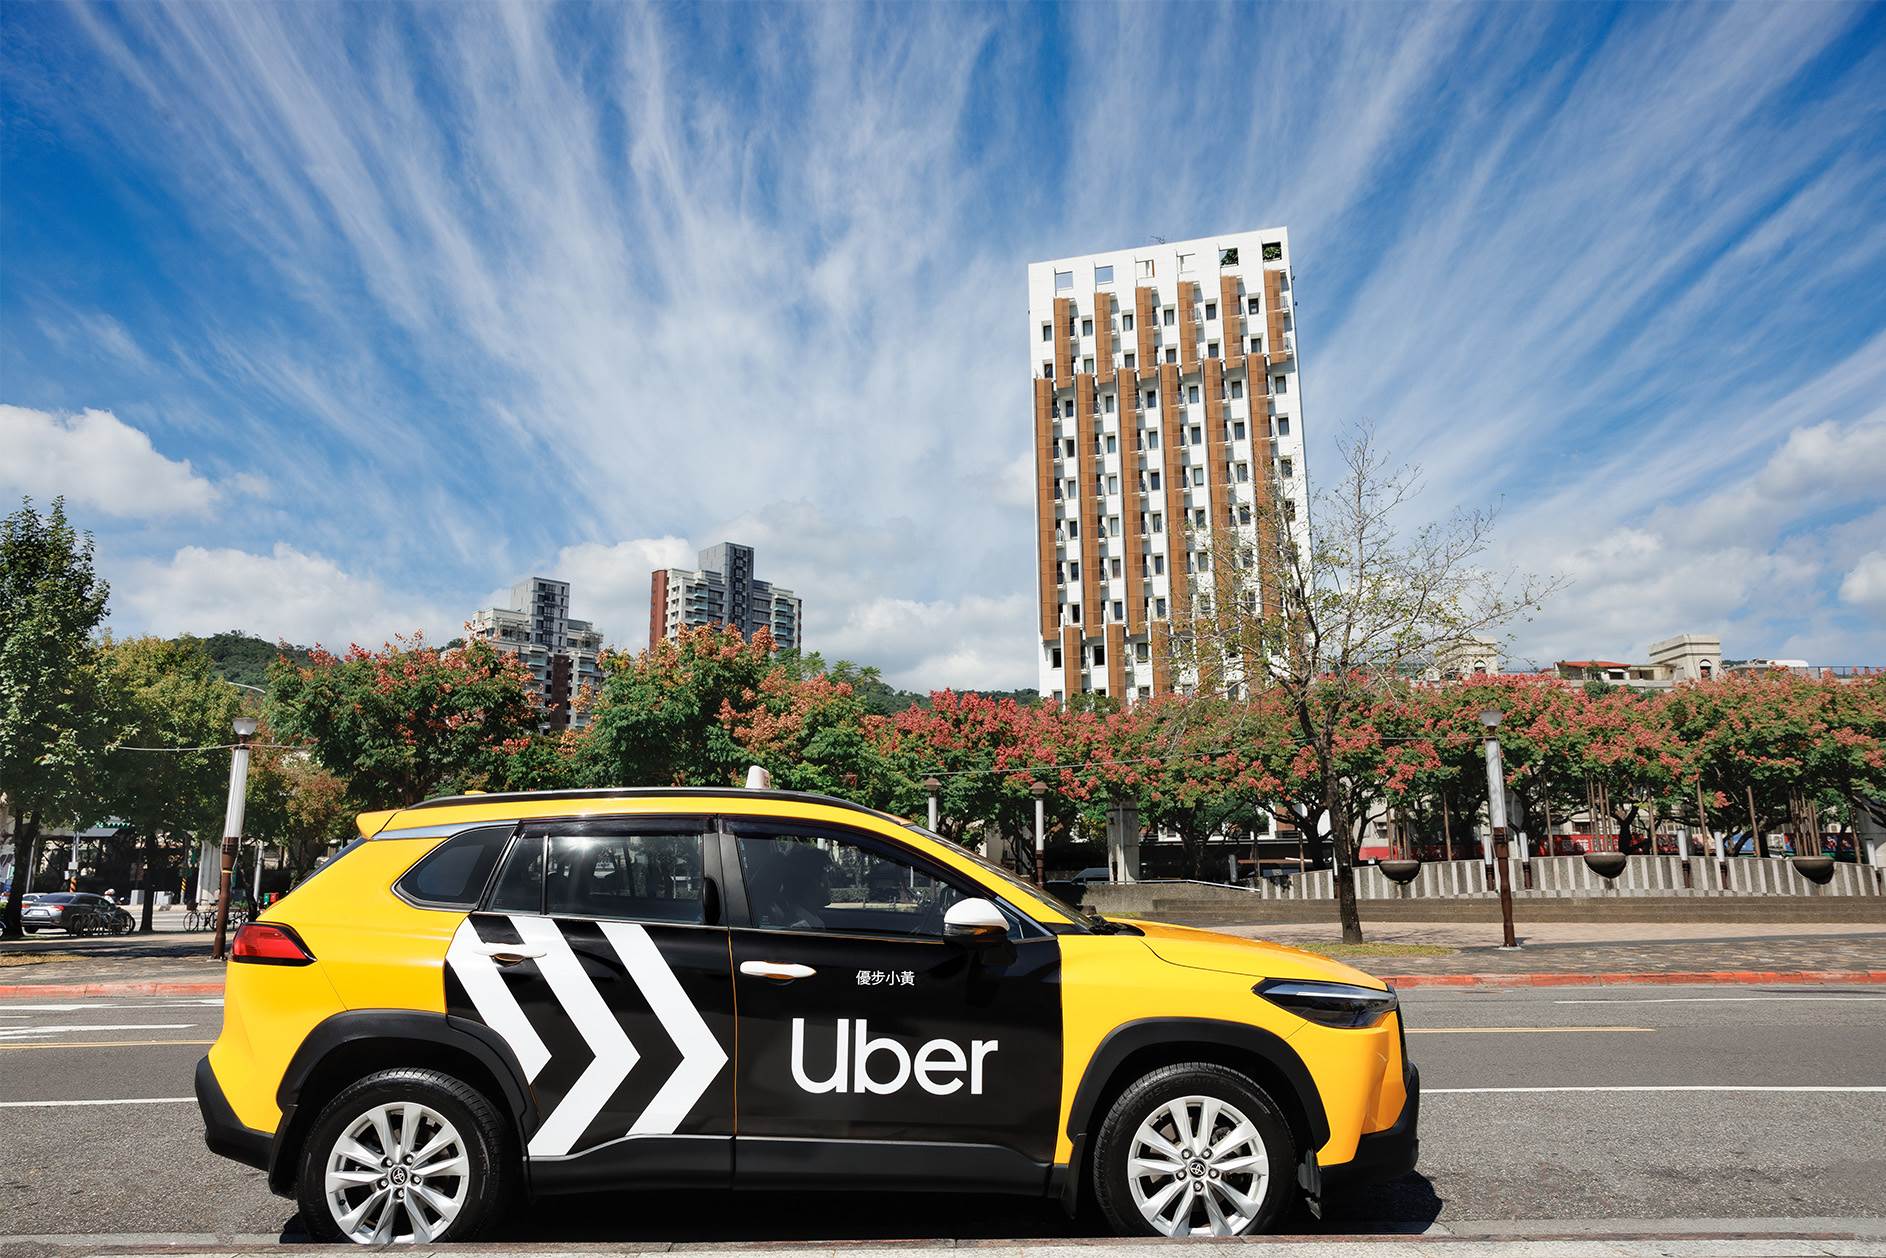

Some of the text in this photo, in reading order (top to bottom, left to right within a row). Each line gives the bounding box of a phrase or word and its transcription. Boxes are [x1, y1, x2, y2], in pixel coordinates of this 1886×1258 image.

[856, 970, 915, 986] 優步小黃
[791, 1018, 998, 1095] Uber
